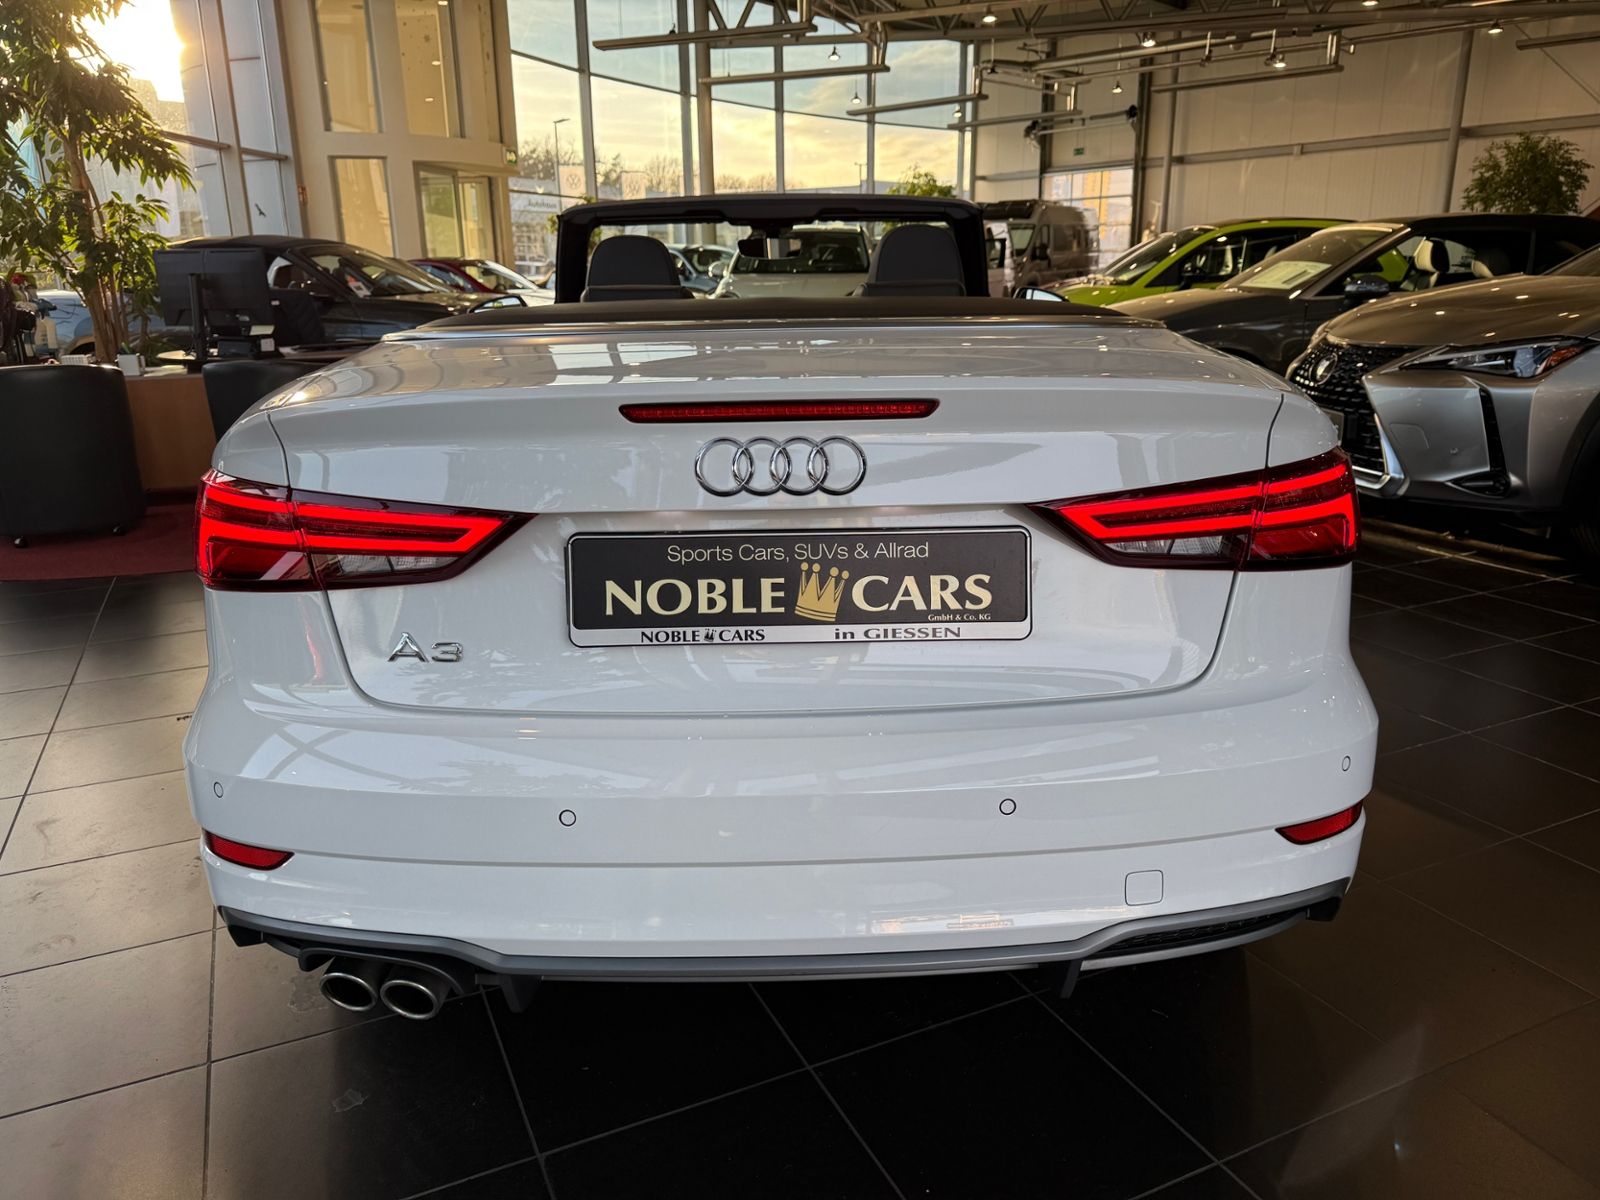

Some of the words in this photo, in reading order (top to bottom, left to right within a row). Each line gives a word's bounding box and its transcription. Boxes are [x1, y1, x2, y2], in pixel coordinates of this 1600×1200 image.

[667, 544, 733, 566] Sports
[738, 543, 790, 563] Cars,
[794, 543, 849, 560] SUVs
[854, 542, 870, 559] &
[874, 541, 929, 559] Allrad
[605, 577, 785, 616] NOBLE
[851, 573, 993, 612] CARS
[928, 613, 953, 622] GmbH
[963, 613, 977, 621] Co.
[979, 613, 991, 621] KG
[387, 631, 463, 663] A3
[641, 630, 700, 643] NOBLE
[718, 629, 766, 642] CARS
[834, 628, 855, 639] in
[863, 627, 961, 640] GIESSEN
